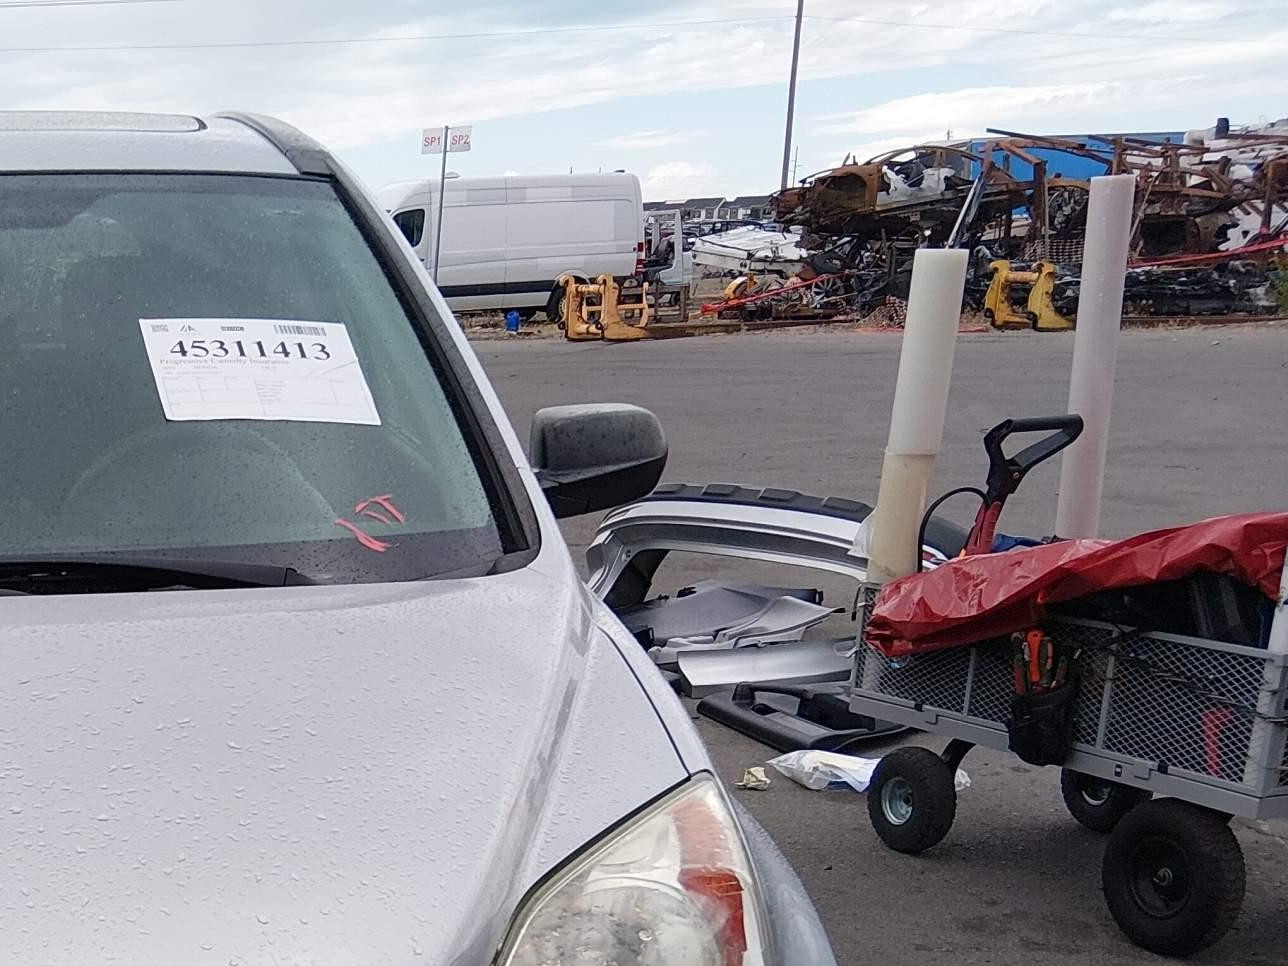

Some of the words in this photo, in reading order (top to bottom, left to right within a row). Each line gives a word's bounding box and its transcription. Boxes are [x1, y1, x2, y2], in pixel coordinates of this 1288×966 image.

[423, 136, 441, 147] SP1
[451, 134, 470, 145] SP2
[170, 339, 331, 361] 45311413
